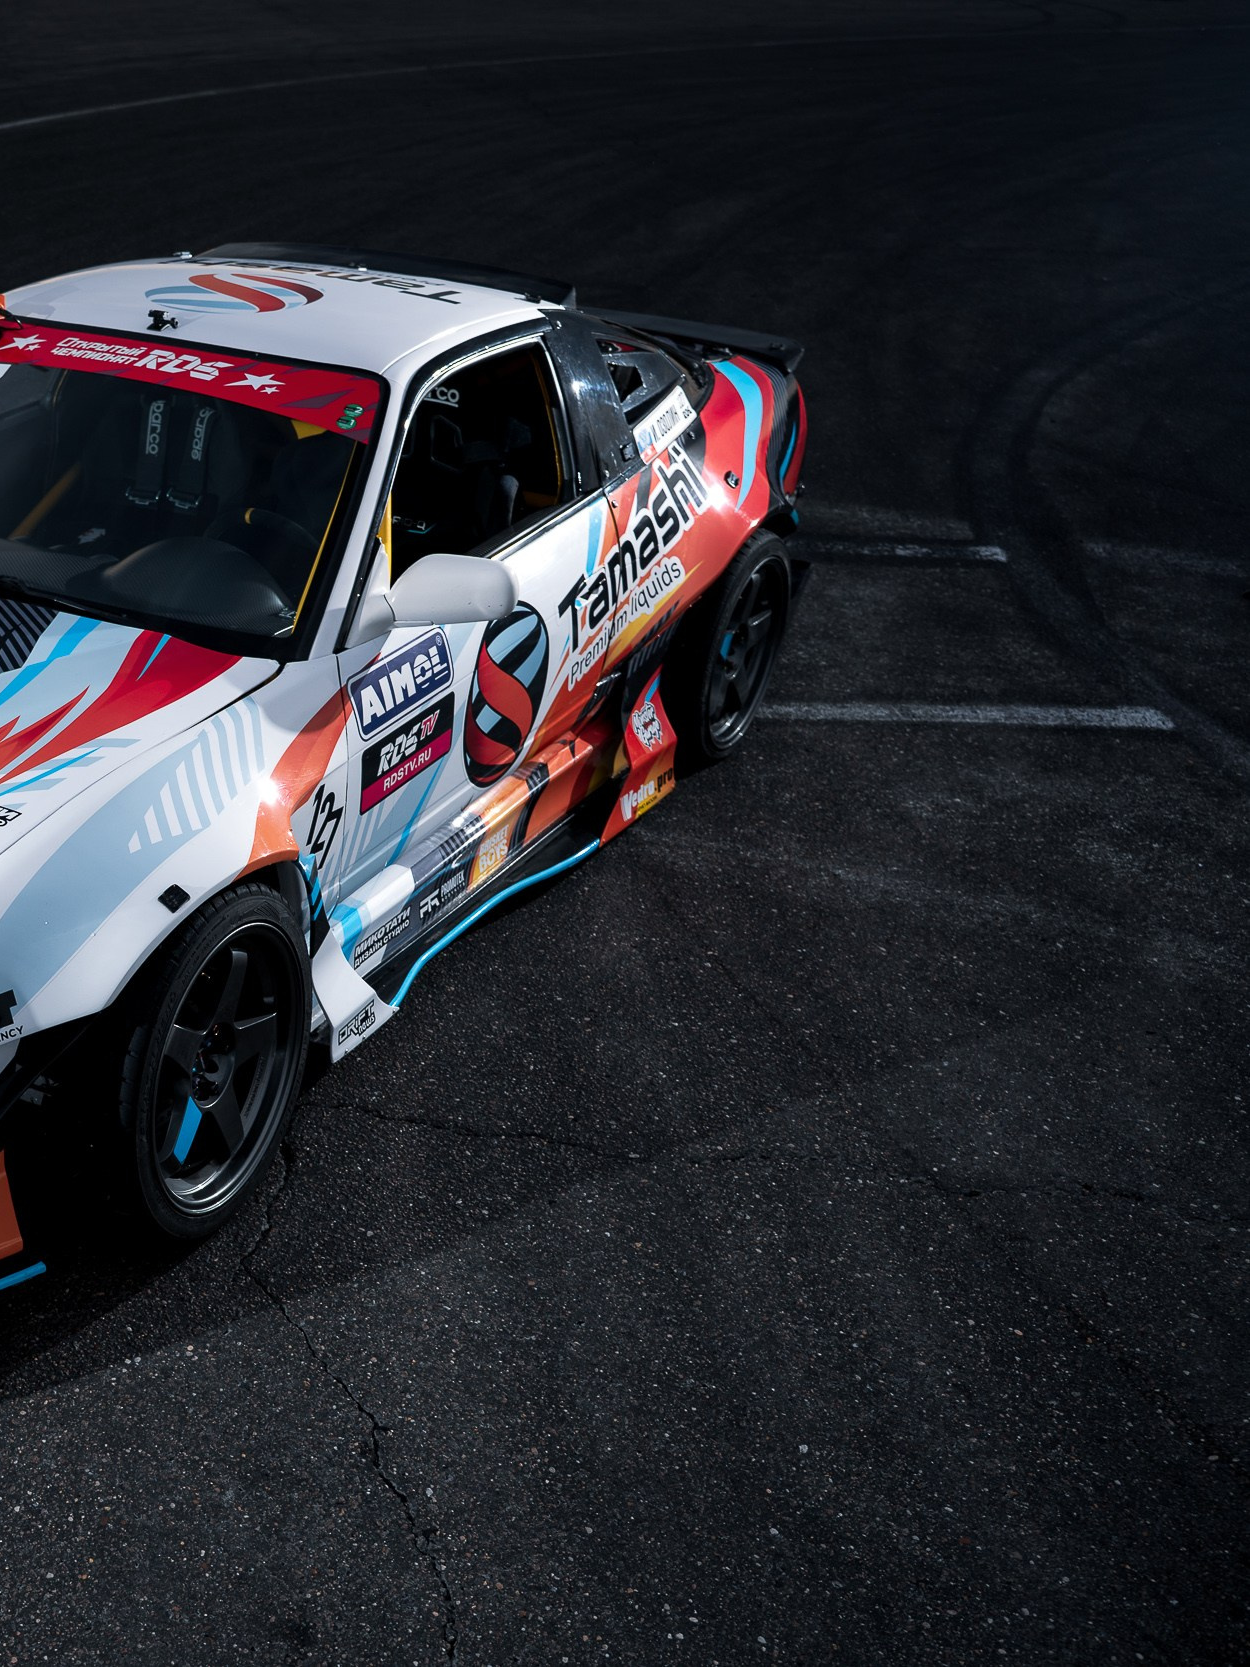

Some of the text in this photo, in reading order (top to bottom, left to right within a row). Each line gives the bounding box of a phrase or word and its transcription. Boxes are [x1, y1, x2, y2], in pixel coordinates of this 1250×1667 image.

[134, 349, 235, 381] RDS
[558, 446, 709, 652] Tamashi
[568, 562, 682, 682] Premium liquids
[361, 645, 449, 727] AIMOL
[377, 722, 422, 777] RDS
[383, 747, 432, 791] RDSTV.RU
[620, 768, 673, 822] Vedro.pro
[306, 783, 344, 871] 127
[479, 838, 508, 874] BOYS
[354, 919, 410, 969] ДИЗАЙН СТУДИО
[355, 906, 411, 957] МИКОТАТИ
